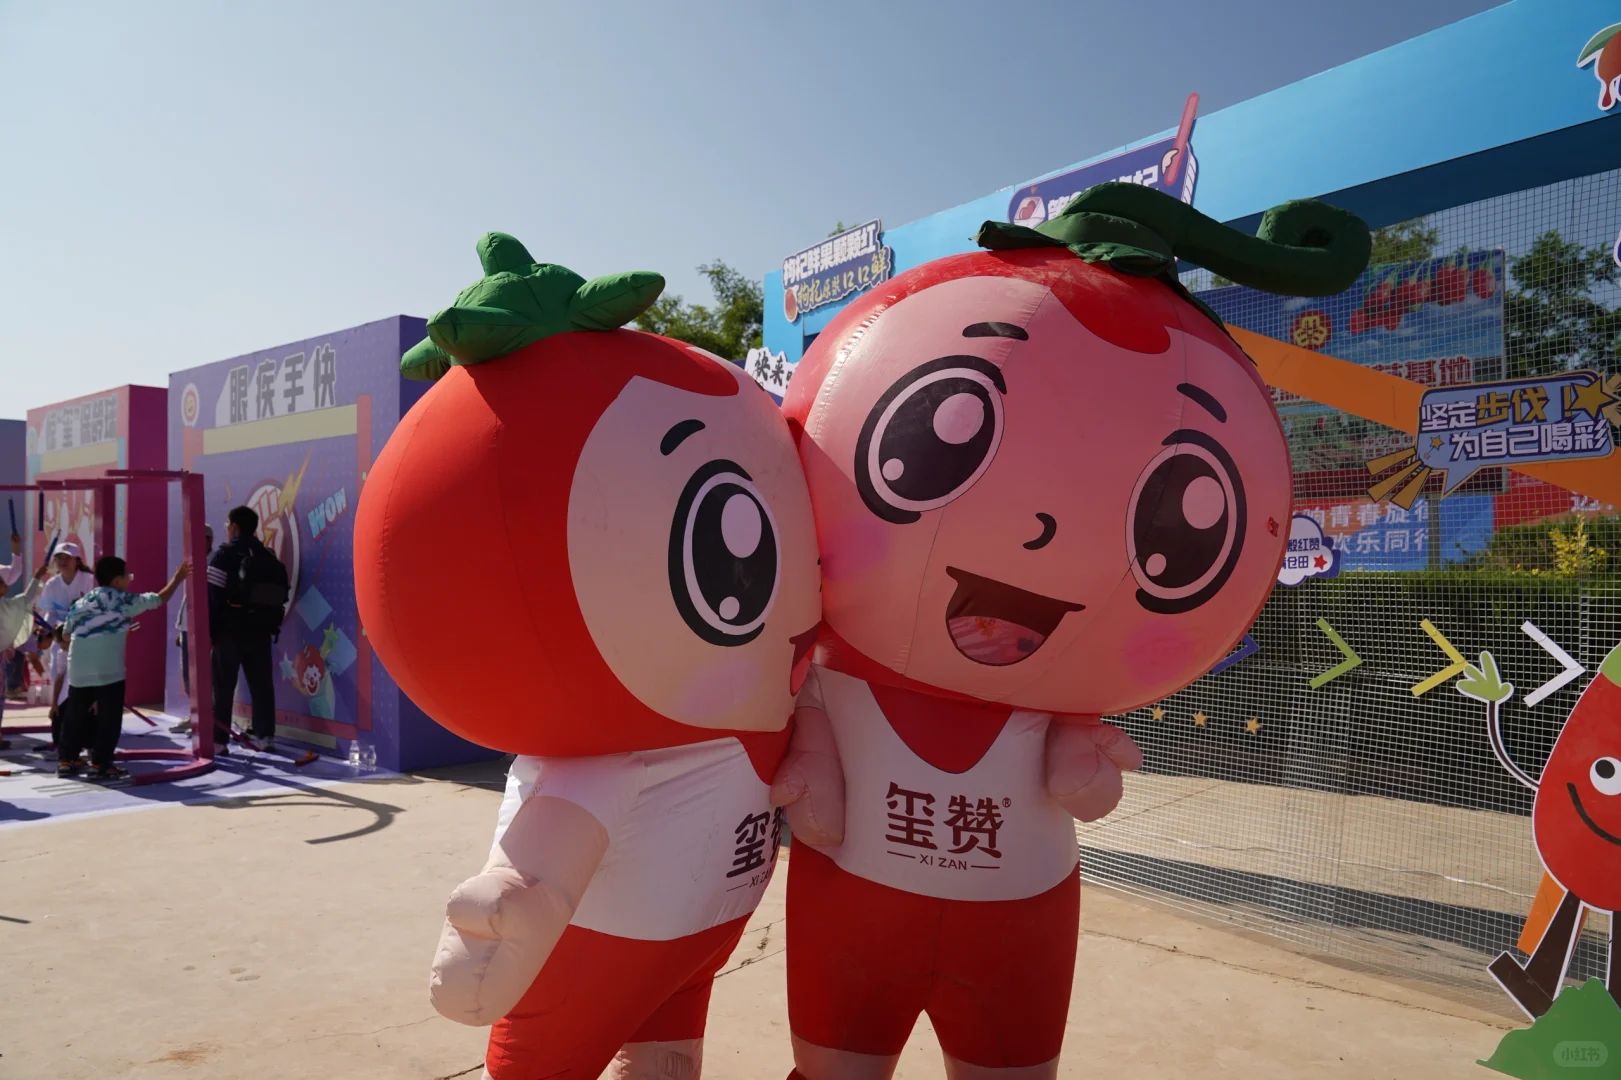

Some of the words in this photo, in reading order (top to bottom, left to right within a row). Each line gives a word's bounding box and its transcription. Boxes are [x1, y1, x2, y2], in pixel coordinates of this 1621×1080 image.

[784, 223, 876, 286] 枸杞鲜果颗颗红
[229, 344, 335, 424] 眼疾手快
[1451, 418, 1609, 460] 为自己喝彩
[308, 487, 347, 541] WOW
[919, 853, 933, 866] XI
[938, 857, 968, 871] ZAN
